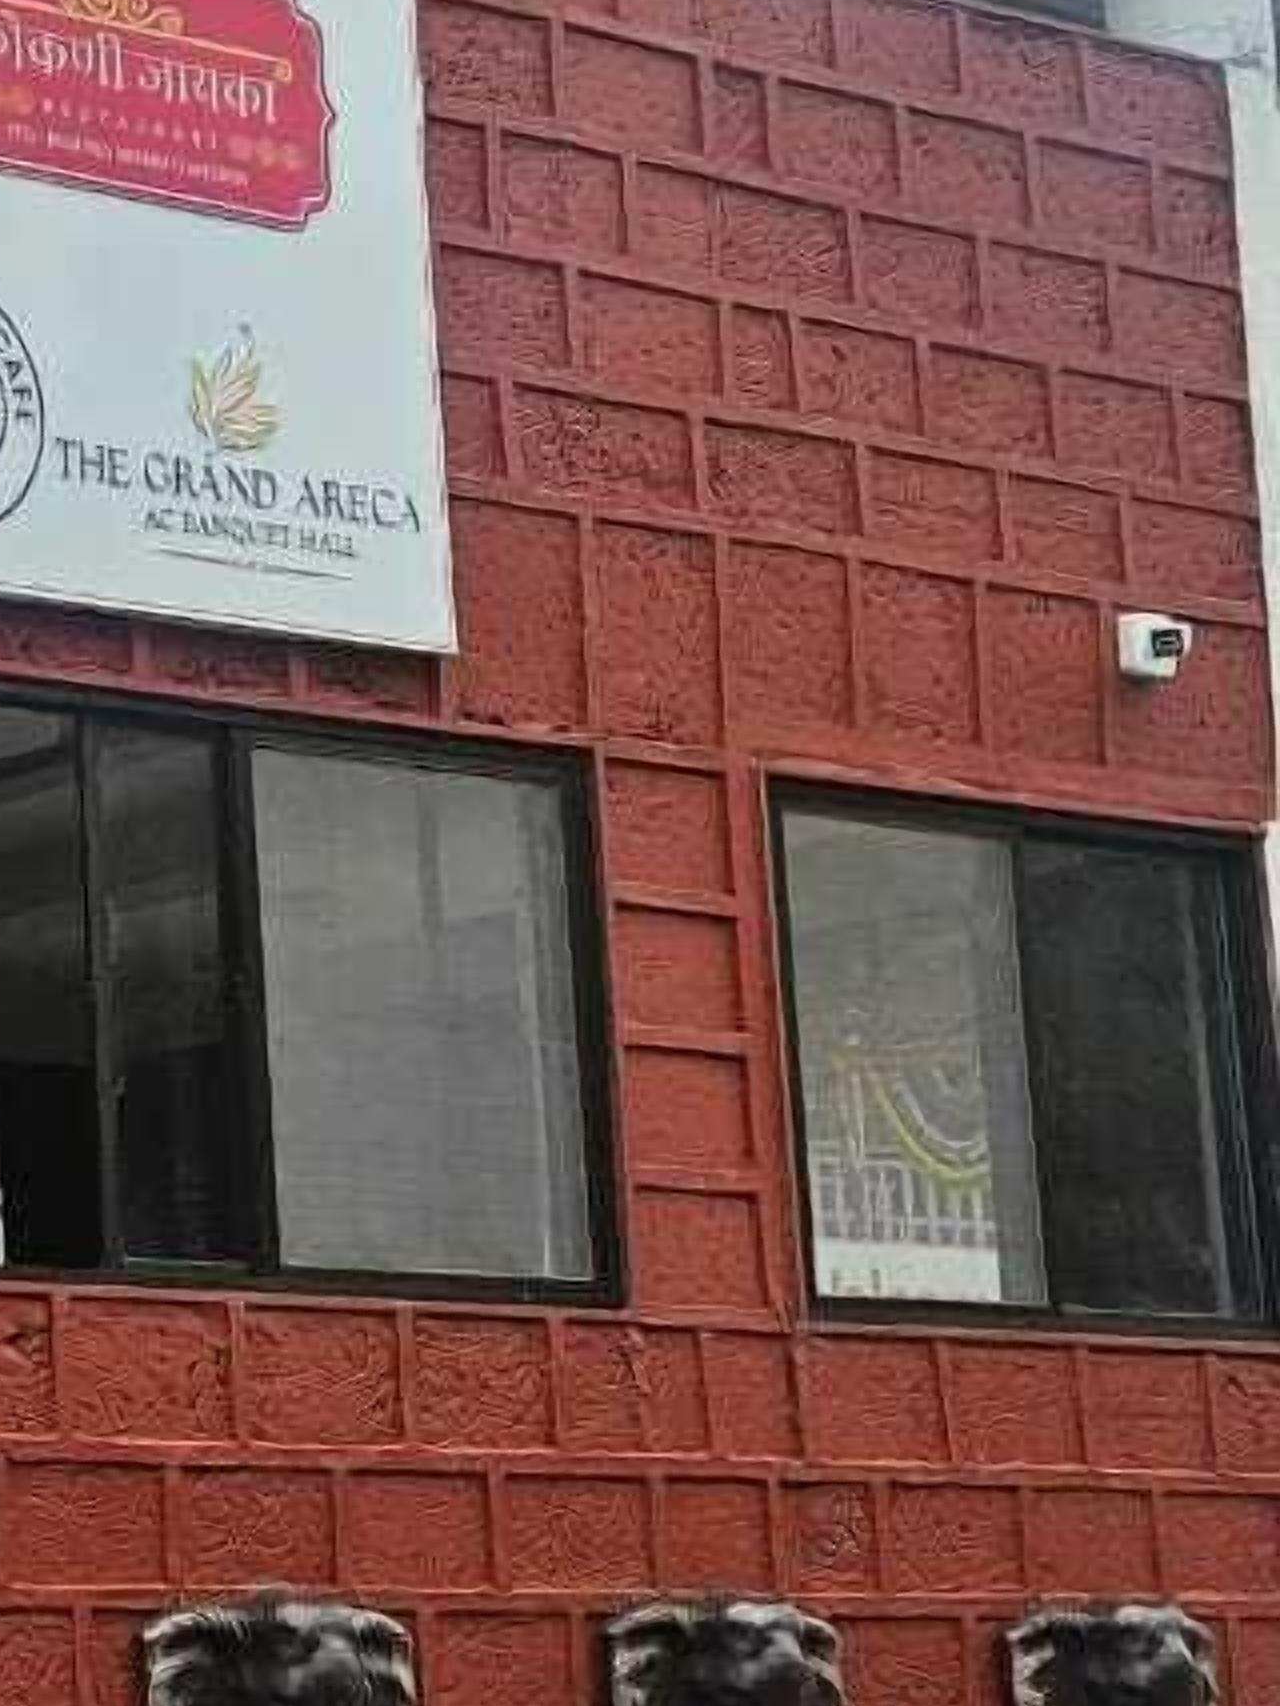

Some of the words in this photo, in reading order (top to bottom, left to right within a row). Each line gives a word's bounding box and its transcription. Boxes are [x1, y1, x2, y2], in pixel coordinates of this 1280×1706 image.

[55, 437, 132, 490] THE
[142, 452, 278, 510] GRAND
[294, 474, 421, 533] ARECA
